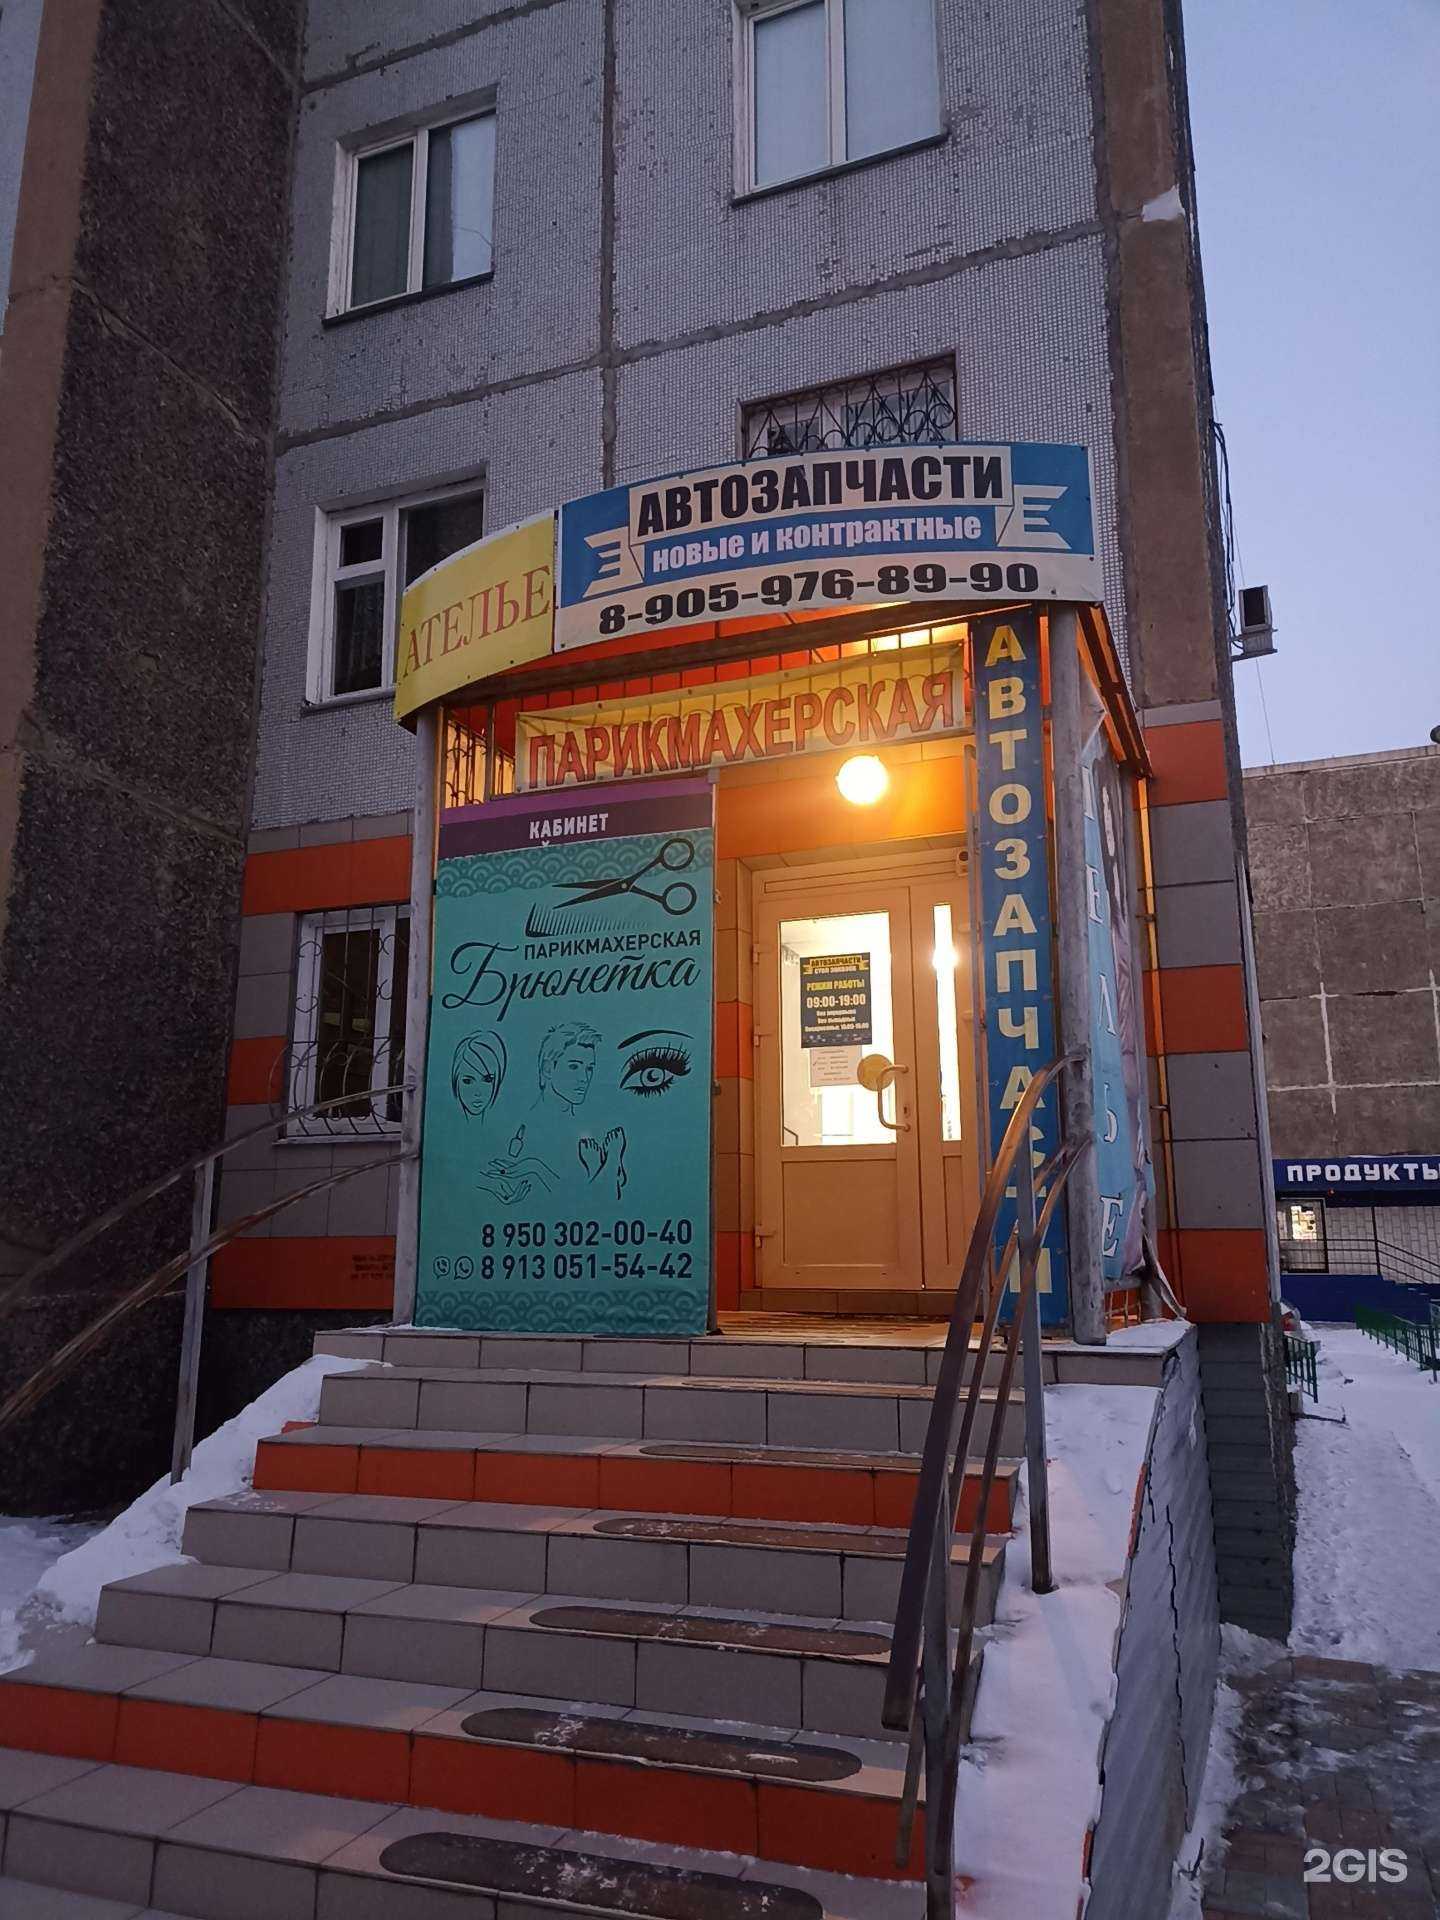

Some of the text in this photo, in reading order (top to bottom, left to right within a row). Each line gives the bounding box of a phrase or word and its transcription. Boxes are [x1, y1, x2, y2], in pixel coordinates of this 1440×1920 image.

[636, 456, 1002, 537] АВТОЗАПЧАСТИ
[652, 515, 982, 572] новые и контрактные
[403, 565, 551, 678] АТЕЛЬЕ
[598, 562, 1039, 635] 8-905-976-89-90
[528, 671, 954, 789] ПАРИКМАХЕРСКАЯ
[529, 813, 609, 839] КАБИНЕТ
[524, 930, 701, 960] ПАРИКМАХЕРСКАЯ
[983, 625, 1053, 1293] АВТОЗАПЧА
[442, 941, 701, 1022] Брюнетка
[806, 994, 866, 1008] 09:00-19:00
[481, 1219, 692, 1247] 8 950 302-00-40
[481, 1252, 692, 1280] 8 913 051-54-42
